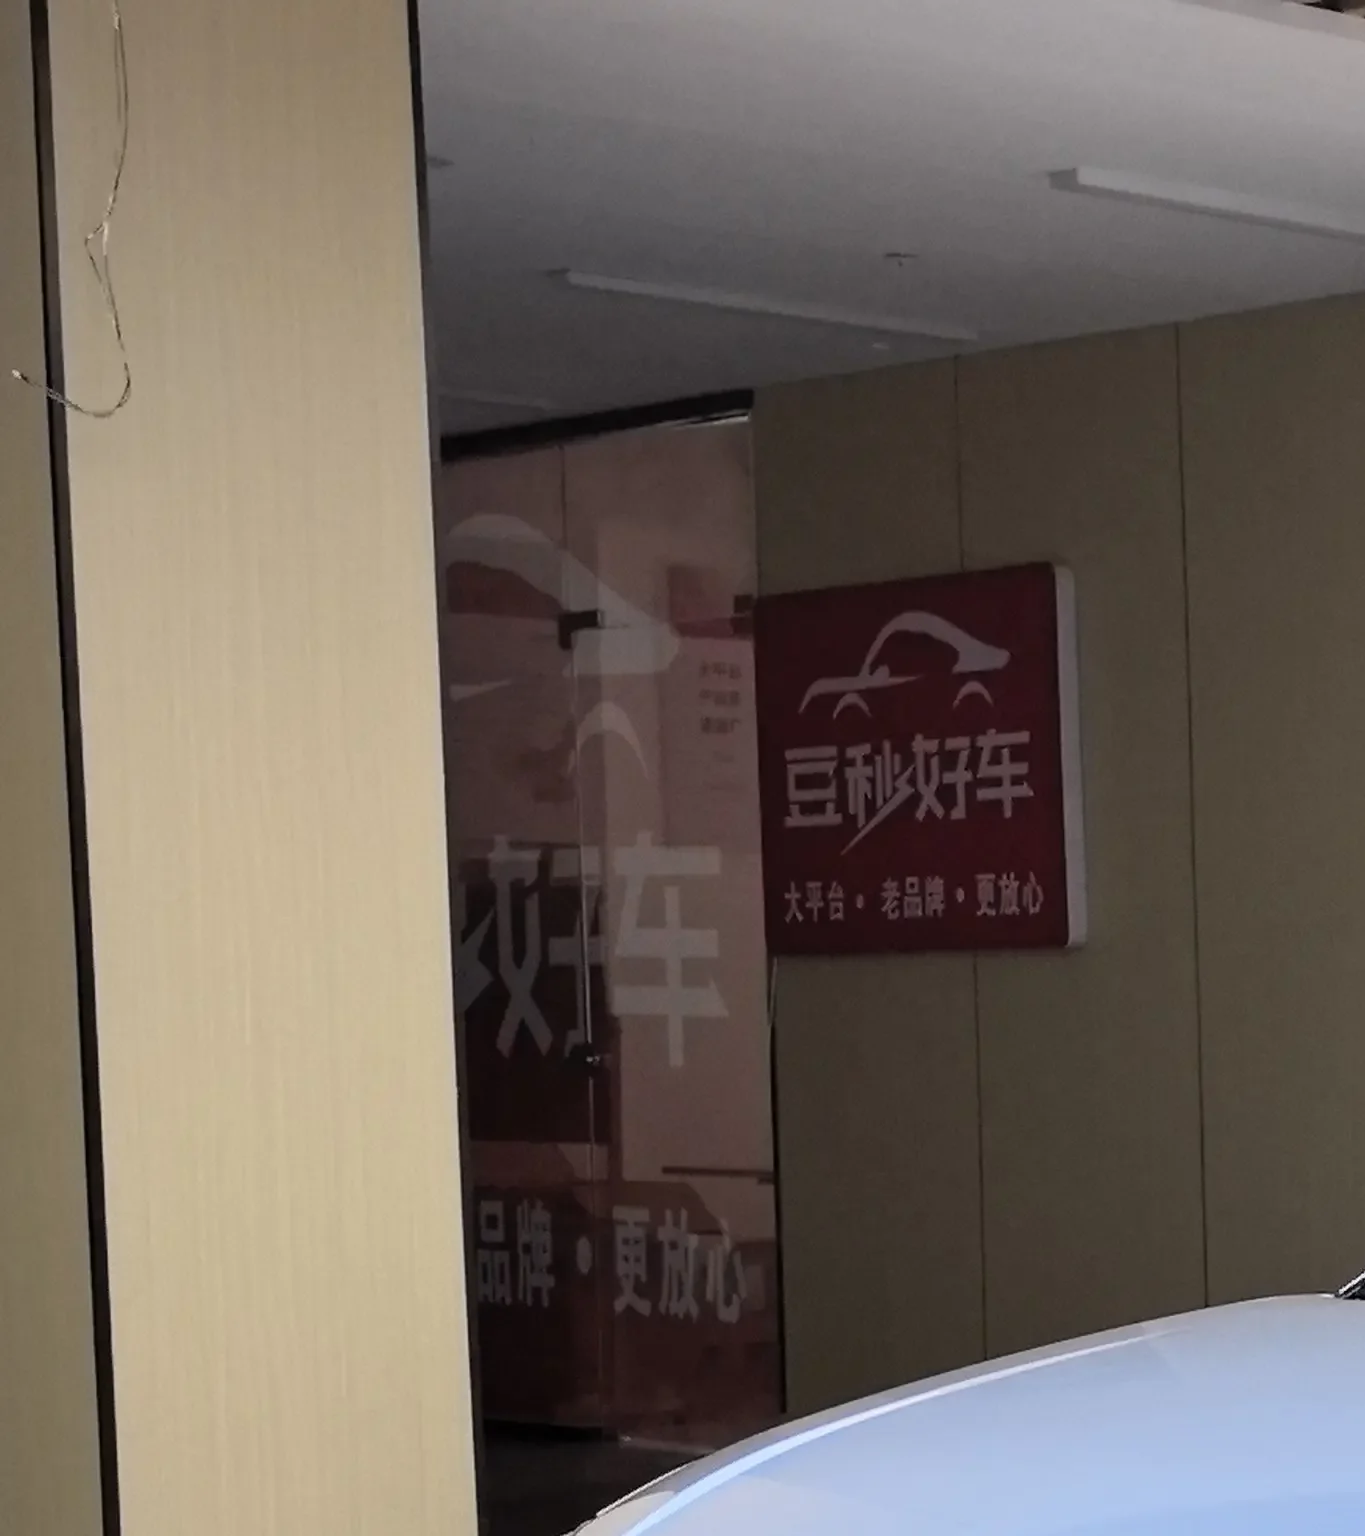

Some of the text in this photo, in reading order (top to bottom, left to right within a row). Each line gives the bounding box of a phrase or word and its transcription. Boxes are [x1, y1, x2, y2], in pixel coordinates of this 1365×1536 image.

[784, 728, 1034, 856] 豆秒好车
[454, 830, 730, 1068] 好车
